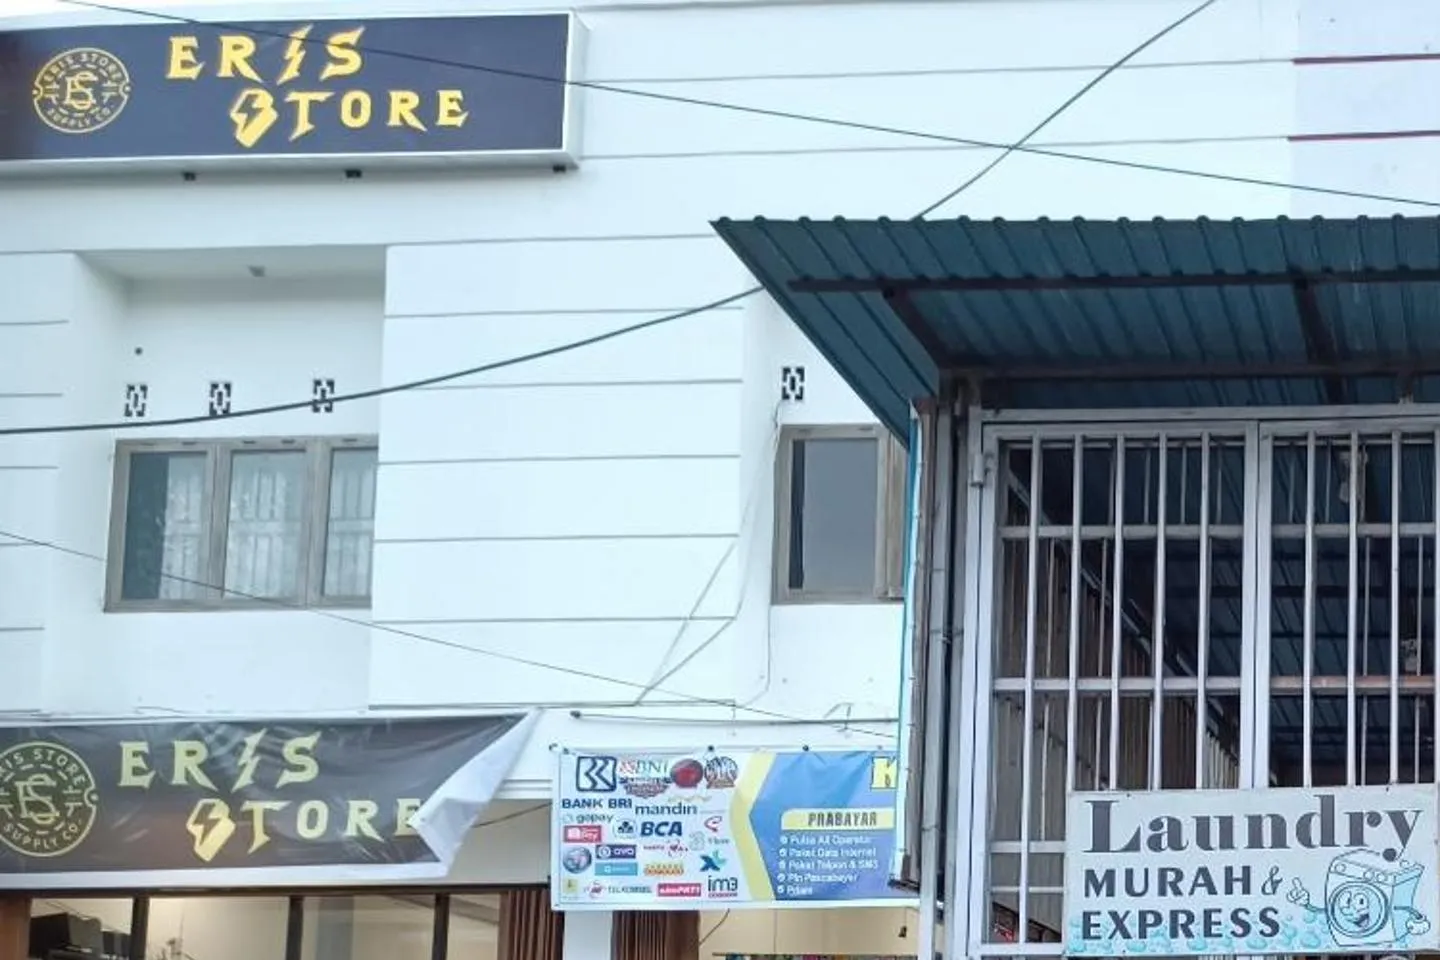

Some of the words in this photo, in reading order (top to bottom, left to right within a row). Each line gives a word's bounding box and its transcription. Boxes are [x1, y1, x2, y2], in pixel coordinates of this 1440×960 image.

[166, 24, 366, 86] ERIS
[119, 728, 323, 793] ERIS
[562, 798, 604, 809] BANK
[608, 798, 633, 809] BRI
[640, 821, 683, 836] BCA
[1083, 794, 1423, 861] Laundry
[1084, 865, 1251, 898] MURAH
[1261, 866, 1283, 896] &
[1083, 907, 1281, 940] EXPRESS
